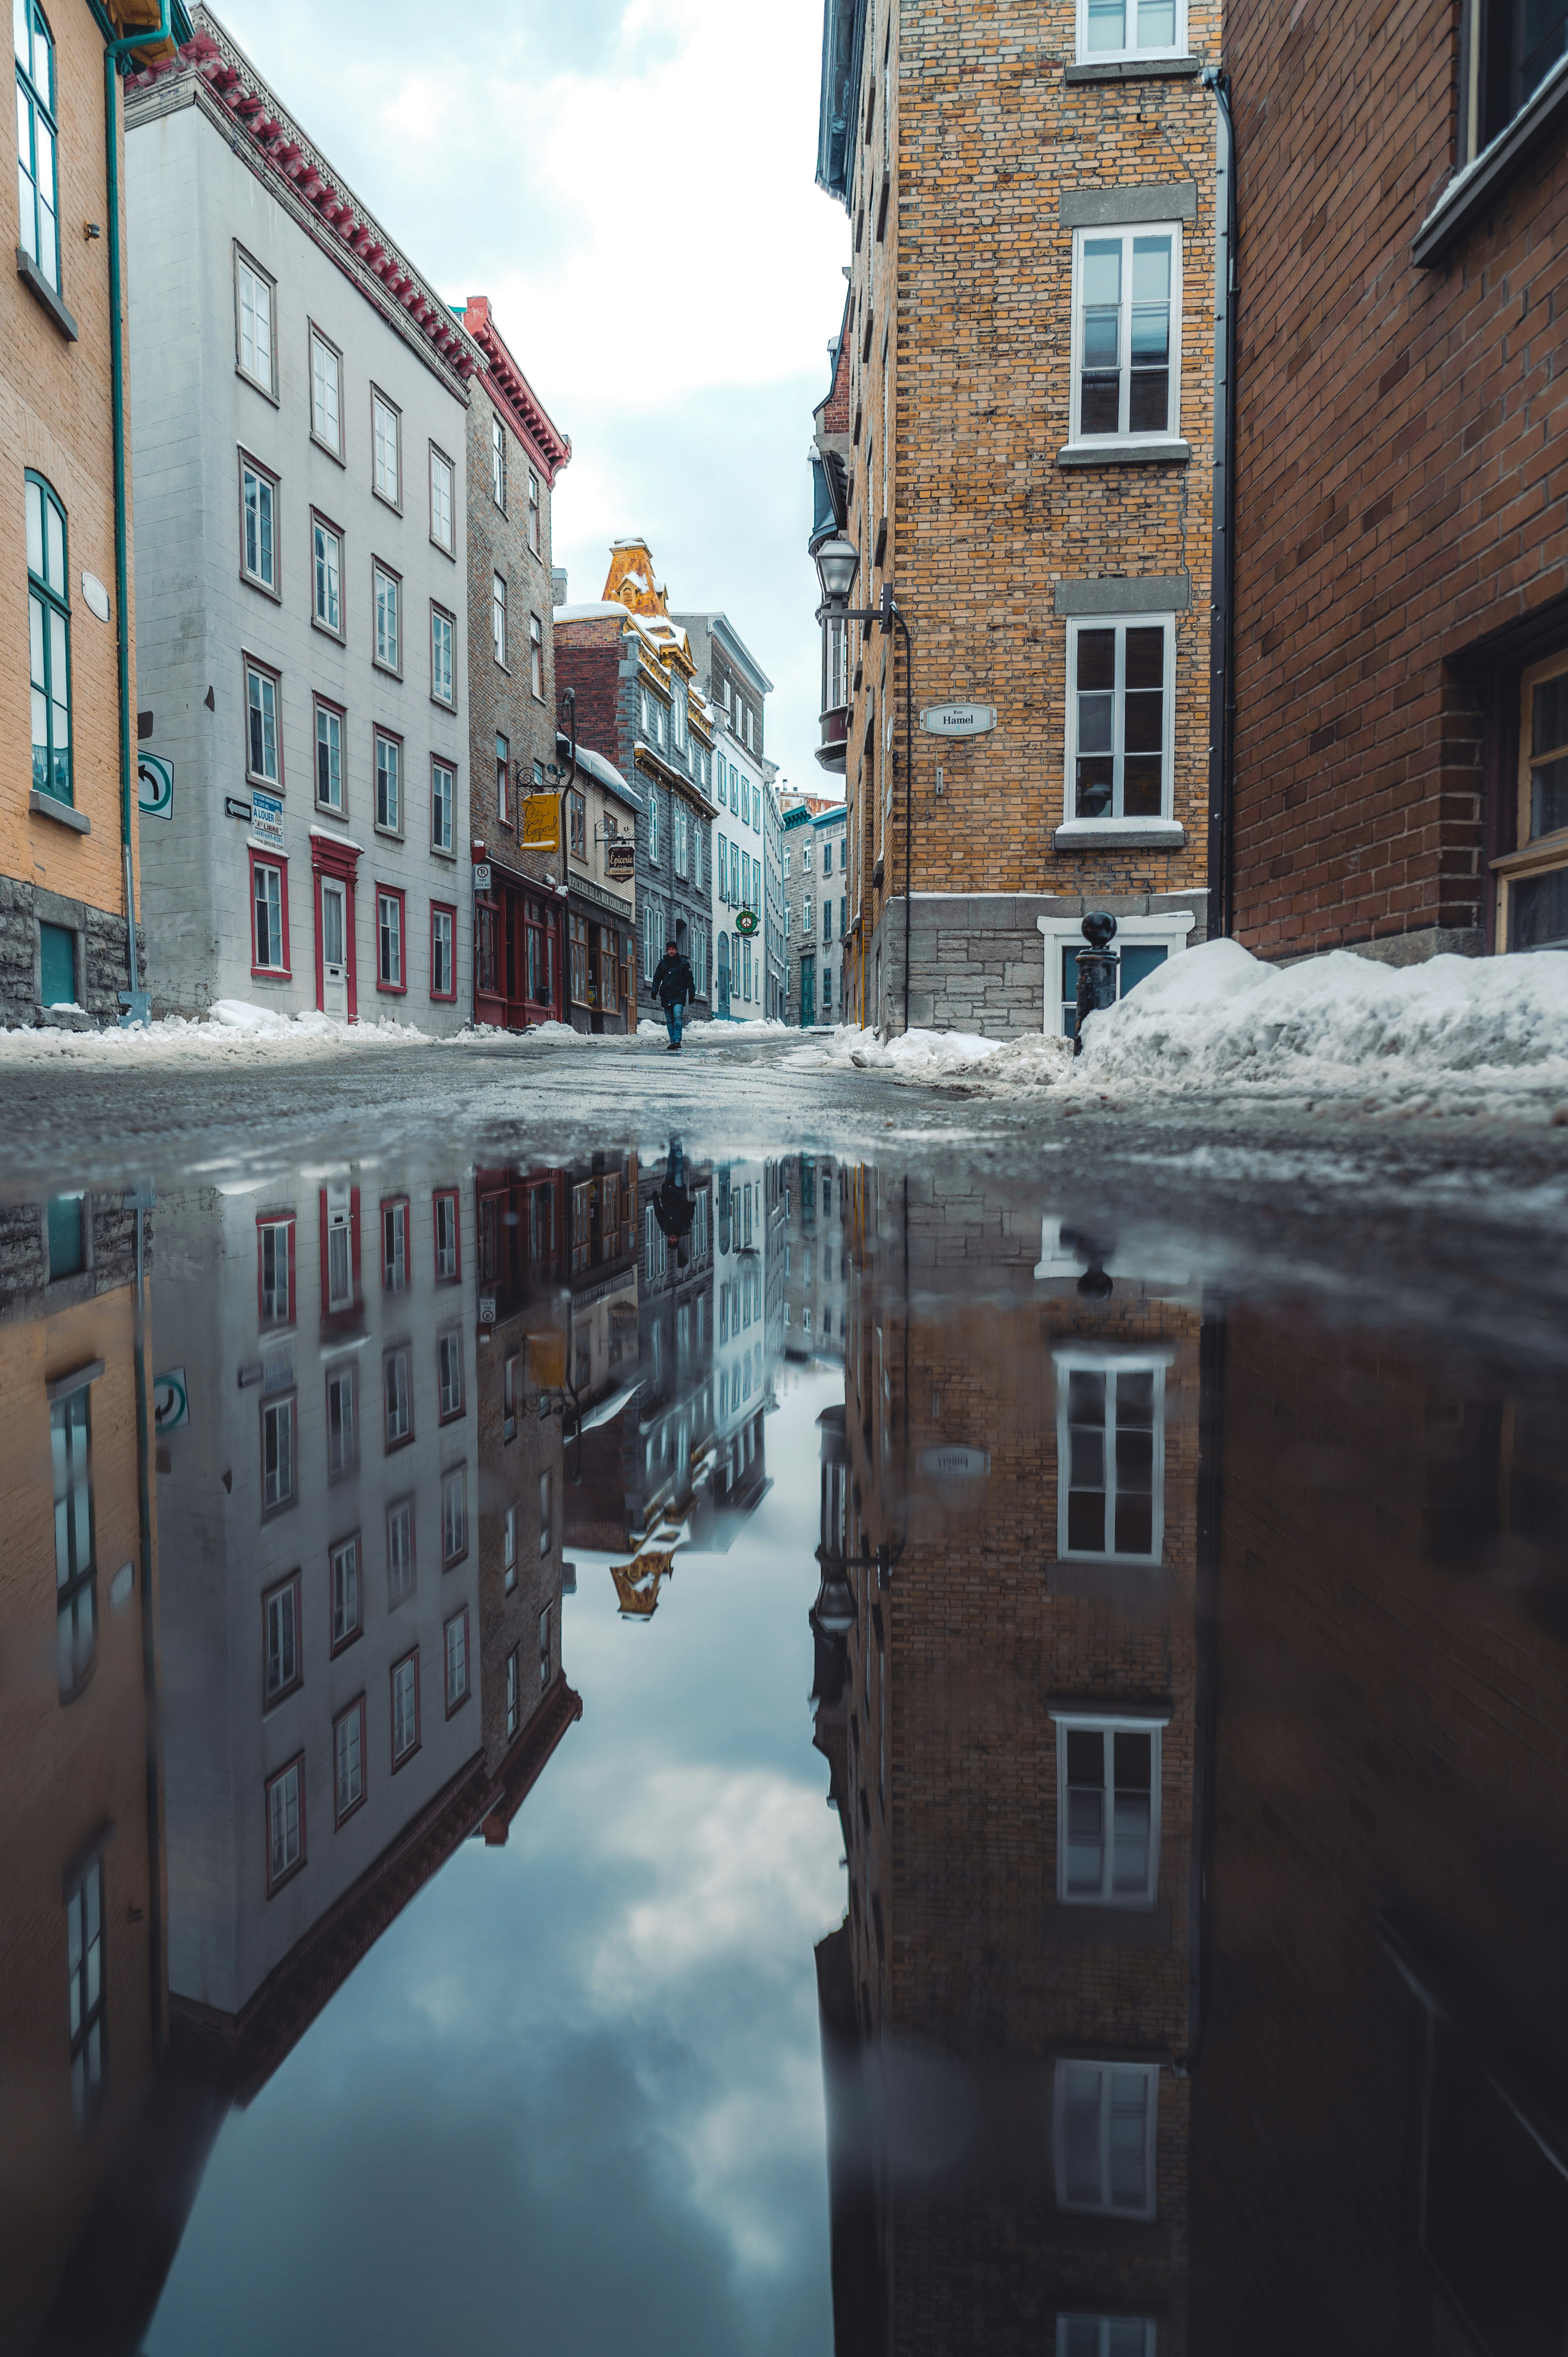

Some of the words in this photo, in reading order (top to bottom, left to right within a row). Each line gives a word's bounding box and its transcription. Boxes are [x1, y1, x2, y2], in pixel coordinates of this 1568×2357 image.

[943, 715, 973, 724] Hamel
[258, 809, 274, 823] LOUER
[525, 799, 549, 825] Chez
[264, 824, 279, 834] LIBRE
[525, 816, 558, 843] Temporel
[610, 851, 633, 867] Épicerie
[569, 876, 589, 895] EPICERIE
[589, 886, 595, 898] DE
[595, 889, 601, 901] LA
[610, 897, 631, 915] COUILLARD
